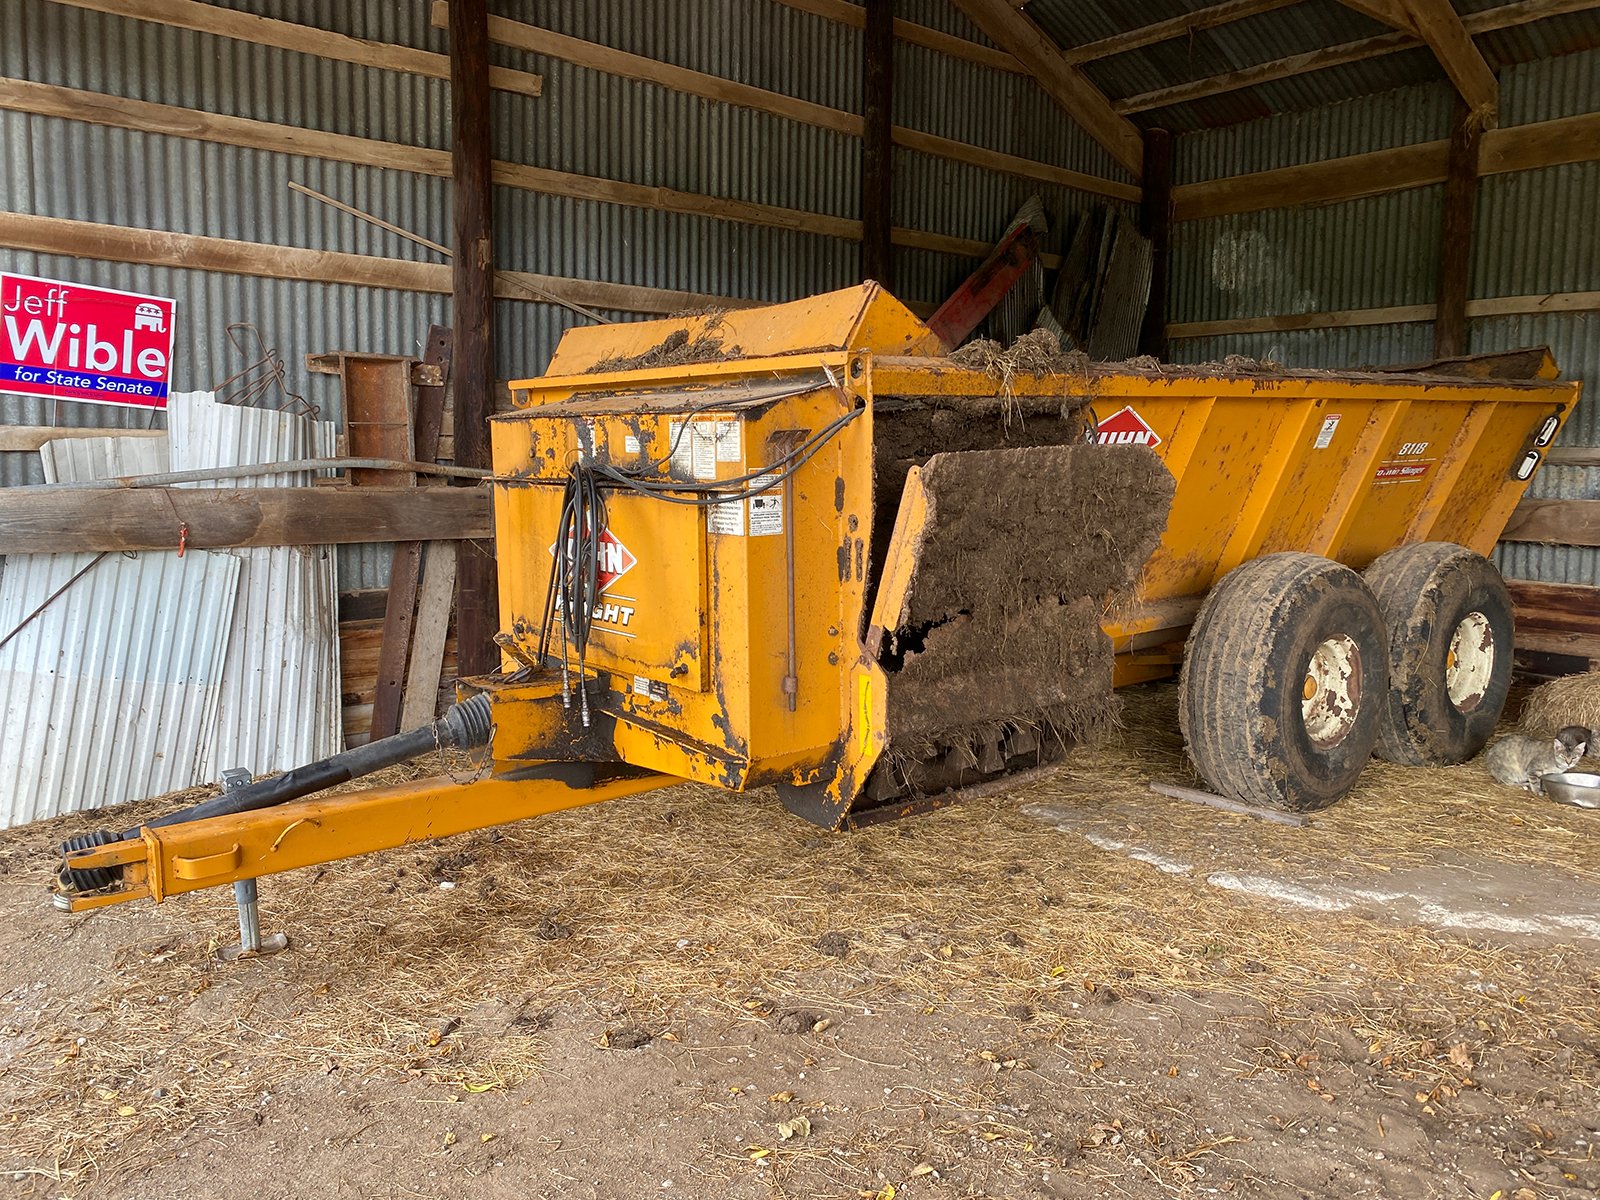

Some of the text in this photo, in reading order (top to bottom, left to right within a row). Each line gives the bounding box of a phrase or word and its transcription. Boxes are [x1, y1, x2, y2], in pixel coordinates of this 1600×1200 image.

[4, 285, 69, 318] Jeff
[4, 315, 166, 378] Wible
[14, 366, 41, 382] for
[45, 371, 91, 389] State
[96, 376, 153, 395] Senate
[1398, 442, 1429, 456] 8118
